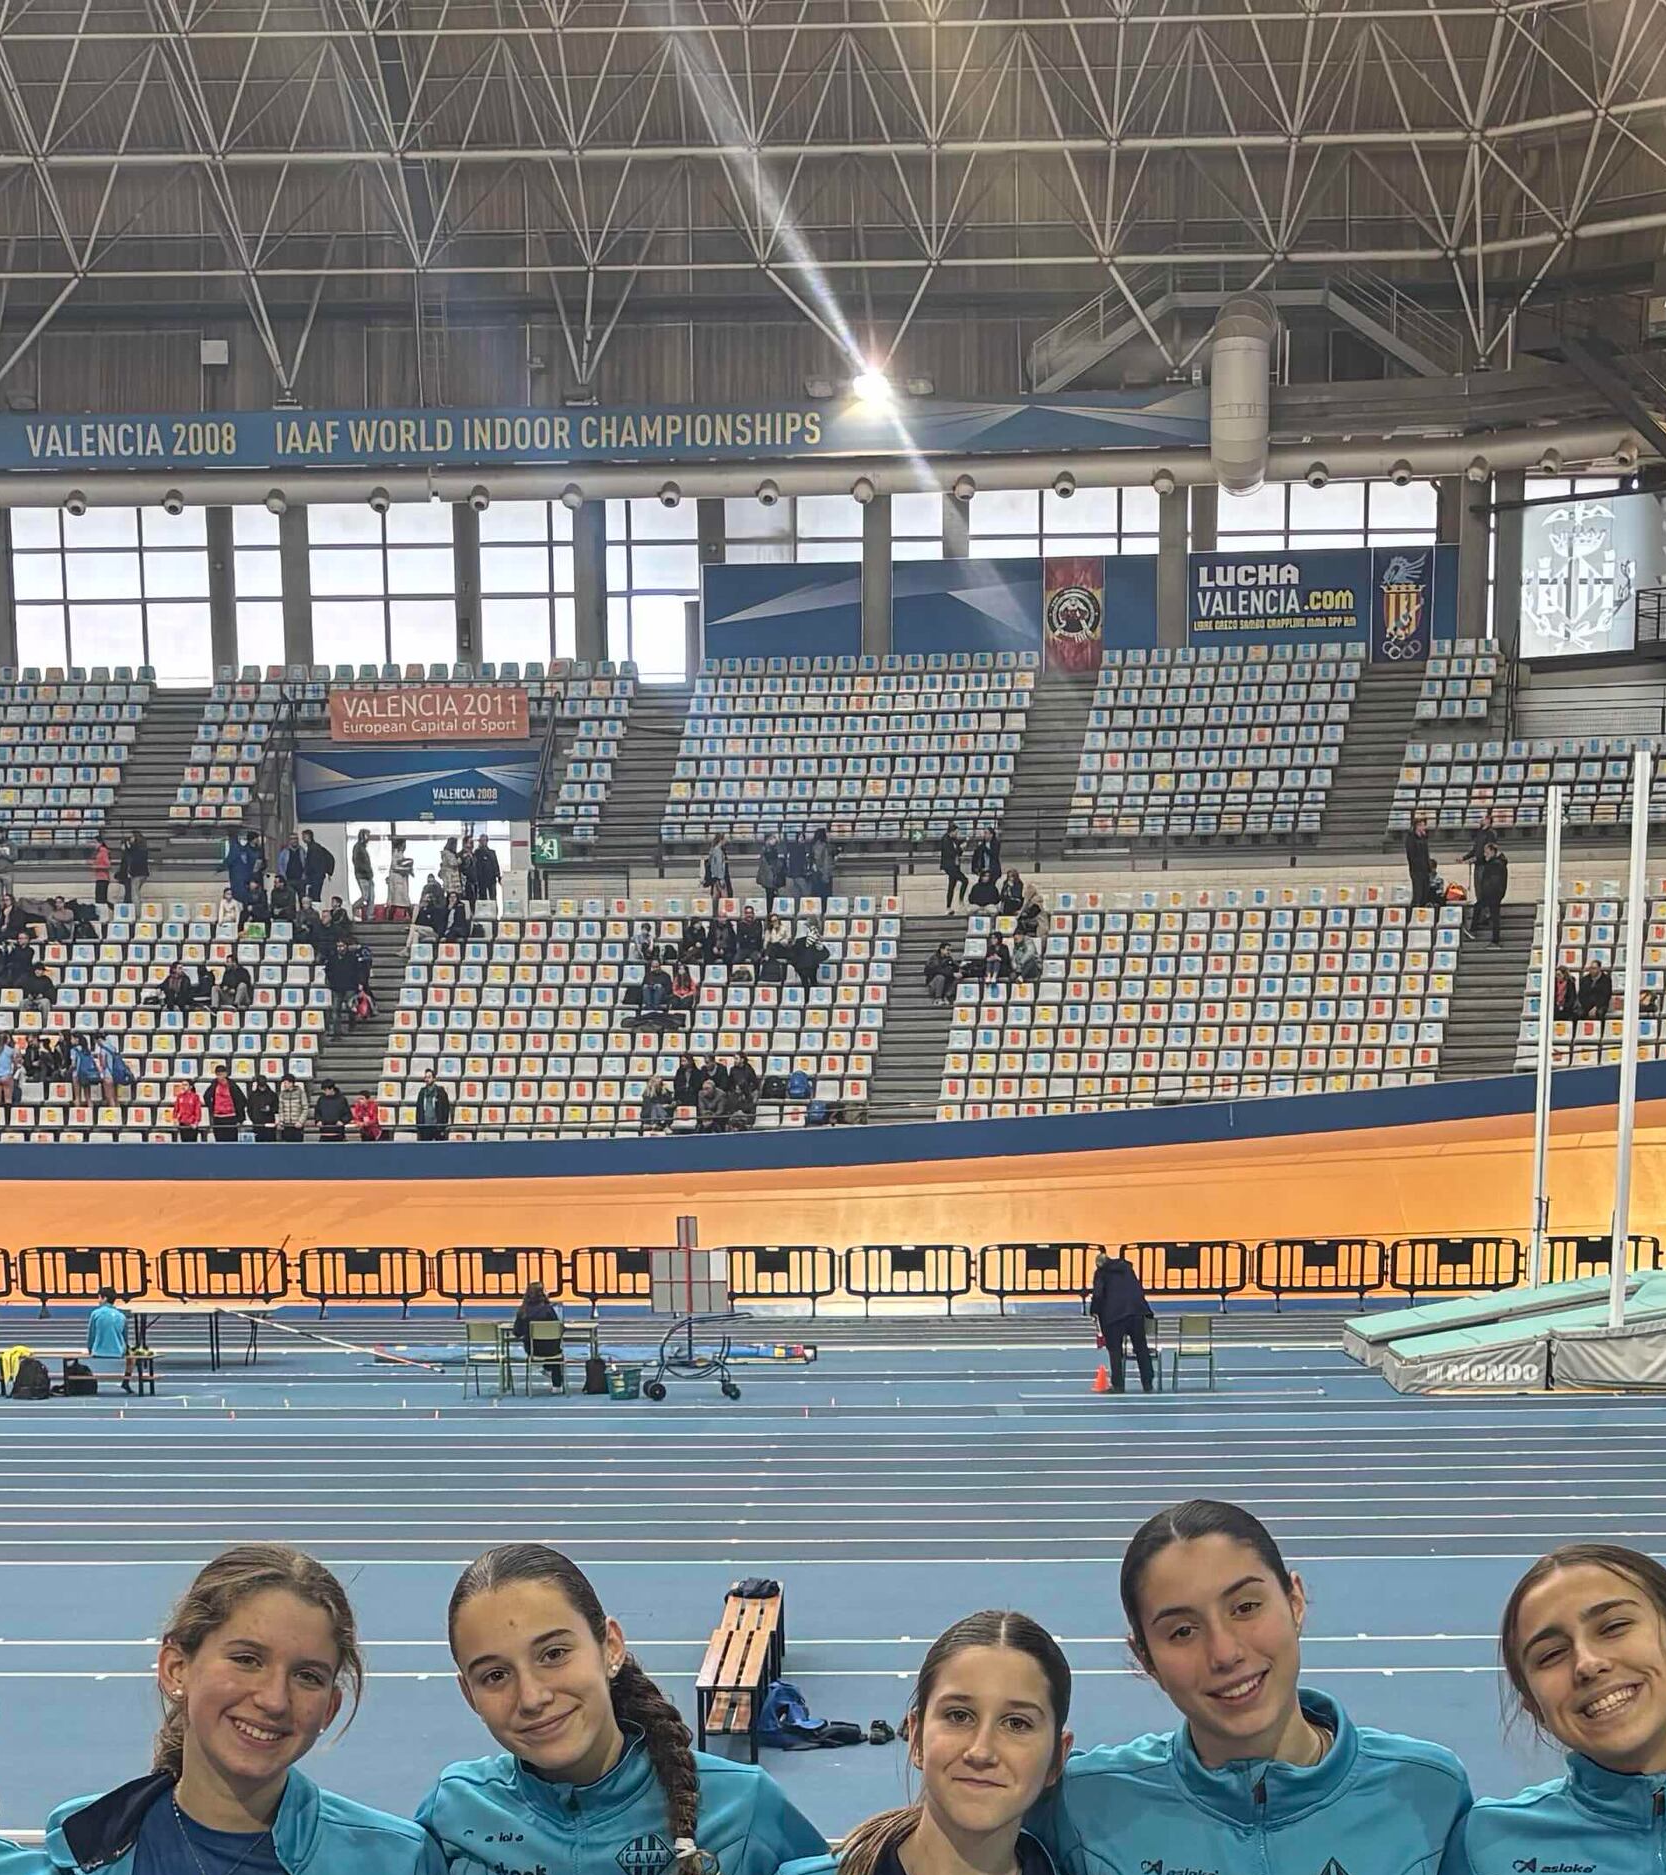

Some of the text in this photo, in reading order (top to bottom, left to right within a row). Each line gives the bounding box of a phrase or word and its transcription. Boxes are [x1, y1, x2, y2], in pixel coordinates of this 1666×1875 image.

[26, 411, 822, 459] VALENCIA 2008 IAAF WORLD INDOOR CHAMPIONSHIPS
[1199, 563, 1299, 587] LUCHA
[1197, 589, 1300, 616] VALENCIA
[343, 693, 518, 718] VALENCIA 2011
[343, 717, 517, 734] European Capital of Sport
[432, 787, 498, 800] VALENCIA 2008
[1446, 1364, 1539, 1382] MONDO
